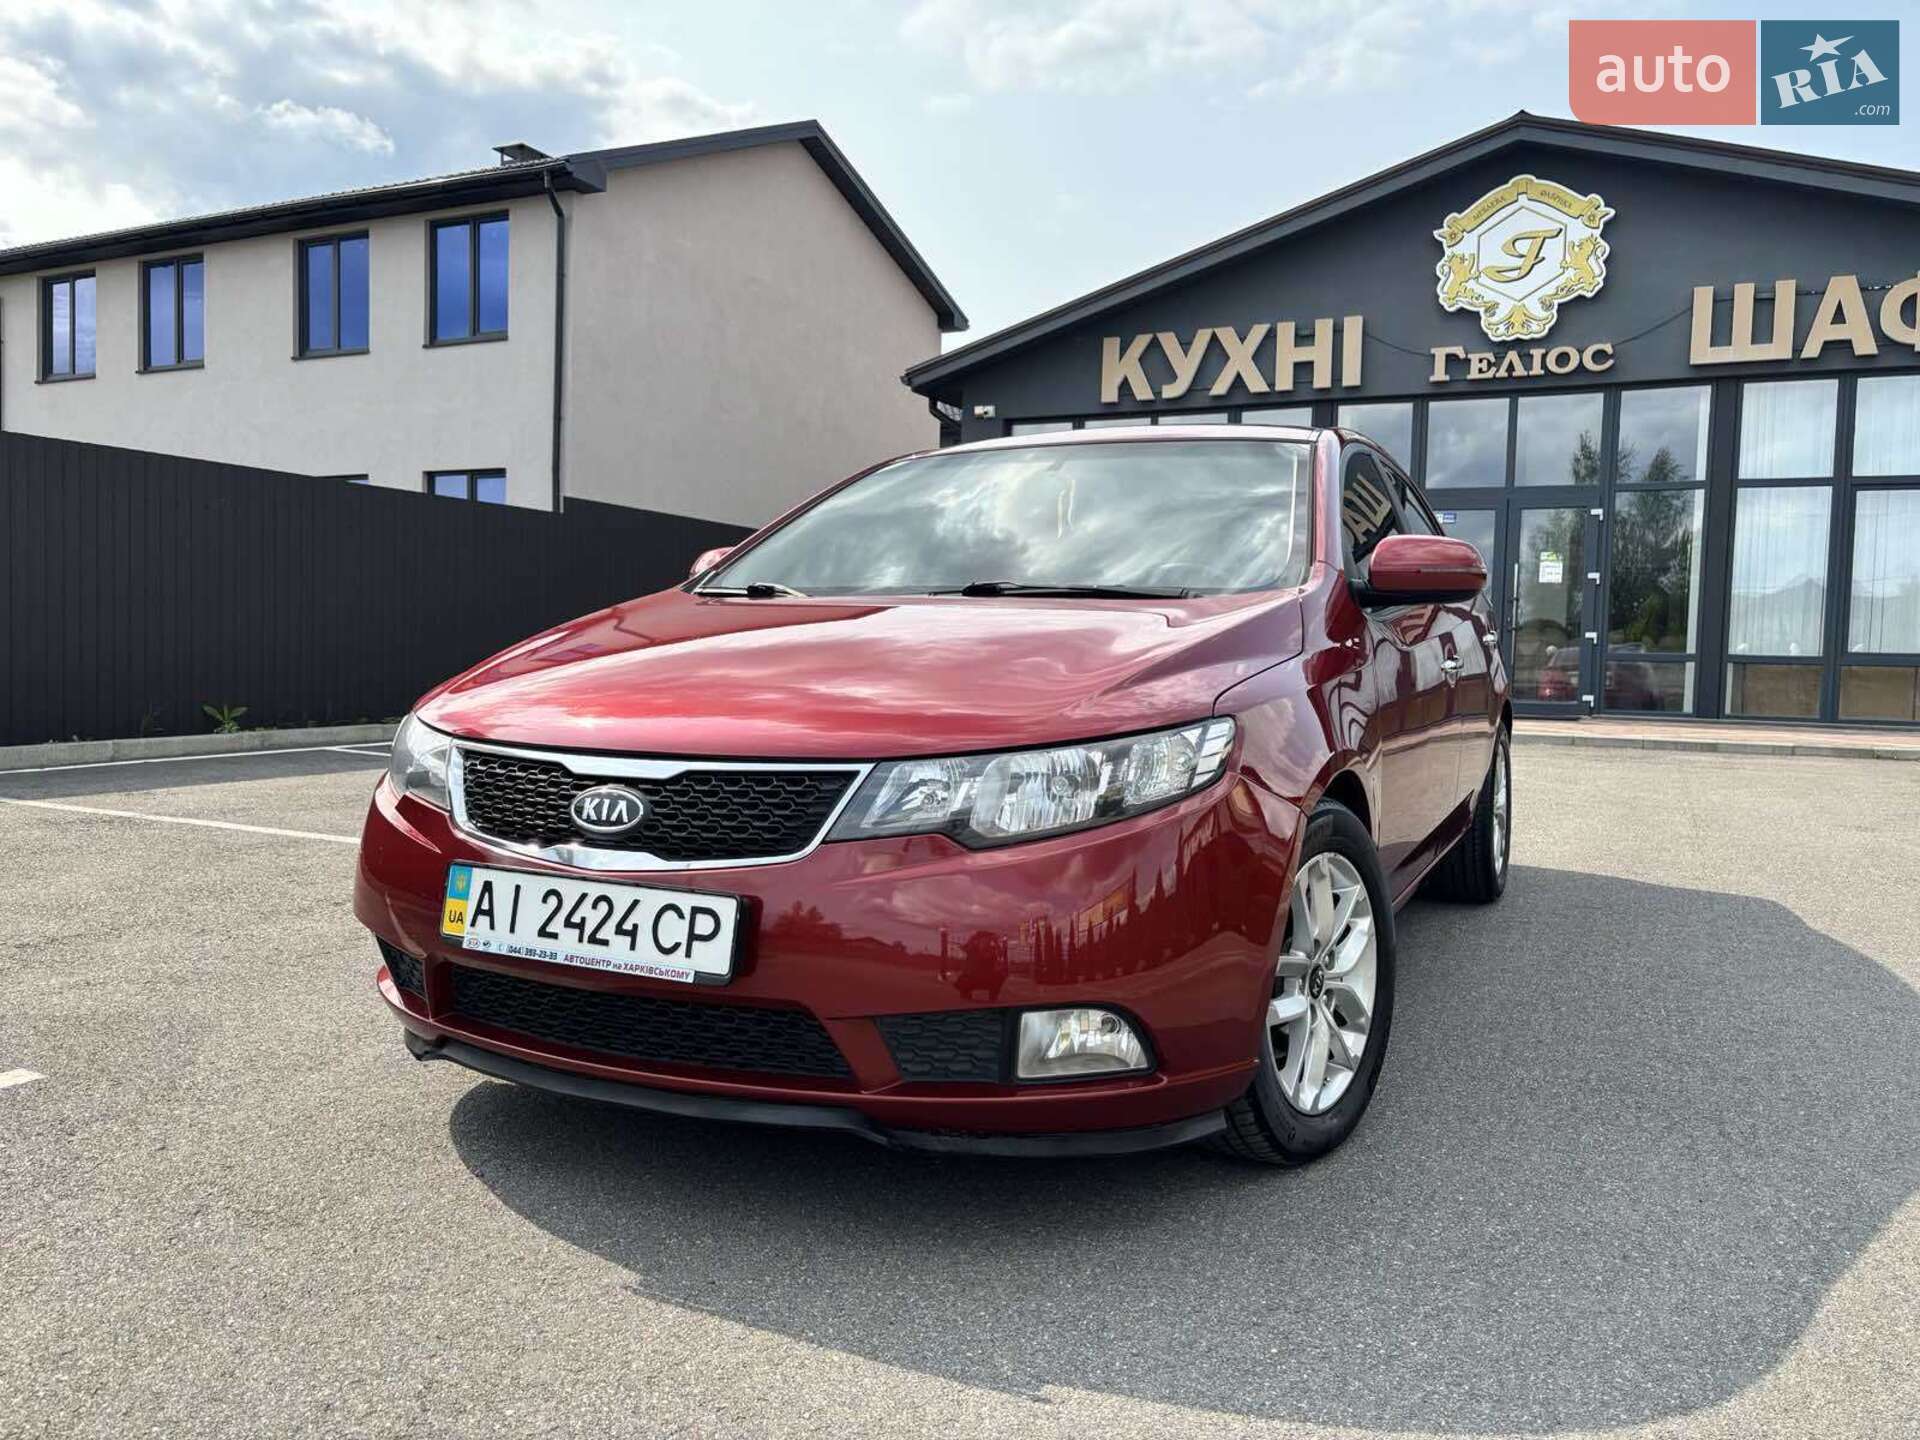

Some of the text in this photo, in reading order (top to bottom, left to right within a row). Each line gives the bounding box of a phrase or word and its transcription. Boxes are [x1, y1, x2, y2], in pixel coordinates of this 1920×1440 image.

[1101, 315, 1363, 403] КУХНІ
[581, 797, 629, 823] KIA
[449, 909, 464, 925] UA
[537, 888, 641, 951] 2424
[564, 954, 612, 968] АВТОЦЕНТР
[623, 963, 690, 980] ХАРКІВСЬКОМУ
